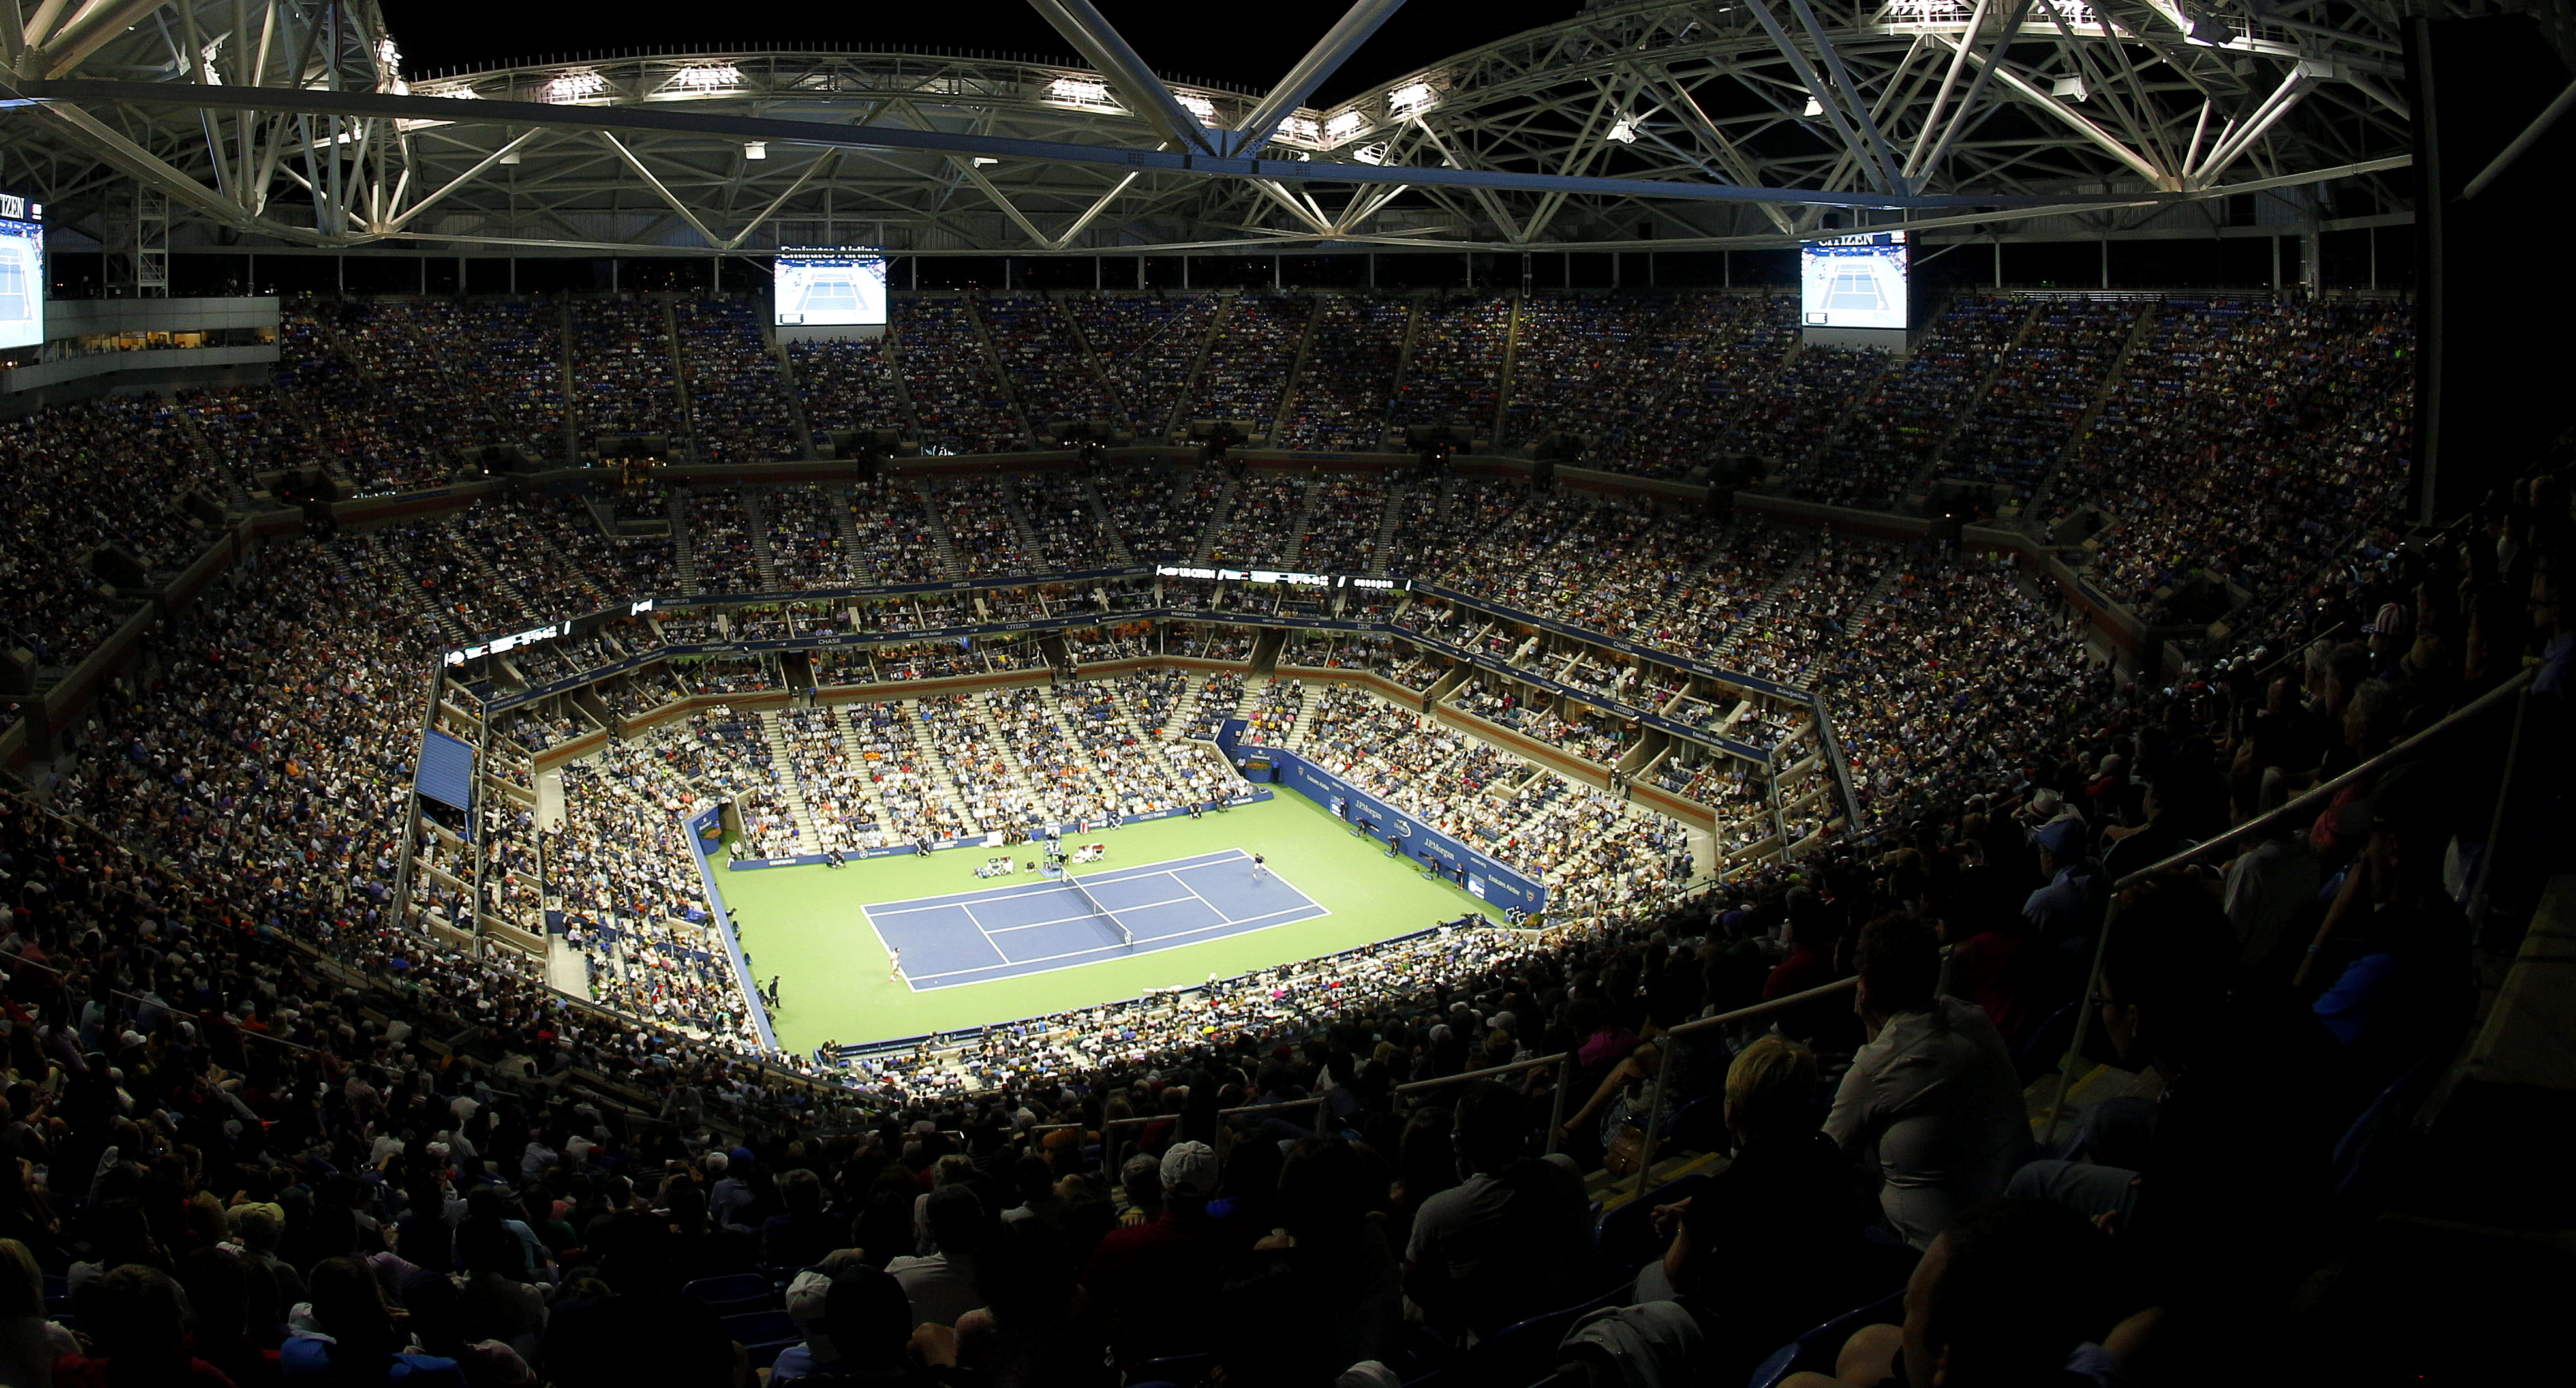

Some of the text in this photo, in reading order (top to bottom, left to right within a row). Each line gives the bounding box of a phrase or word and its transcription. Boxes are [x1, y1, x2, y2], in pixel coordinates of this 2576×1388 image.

[0, 193, 25, 219] IZEN
[1613, 641, 1632, 652] CHASE
[1614, 704, 1635, 716] CITIZEN
